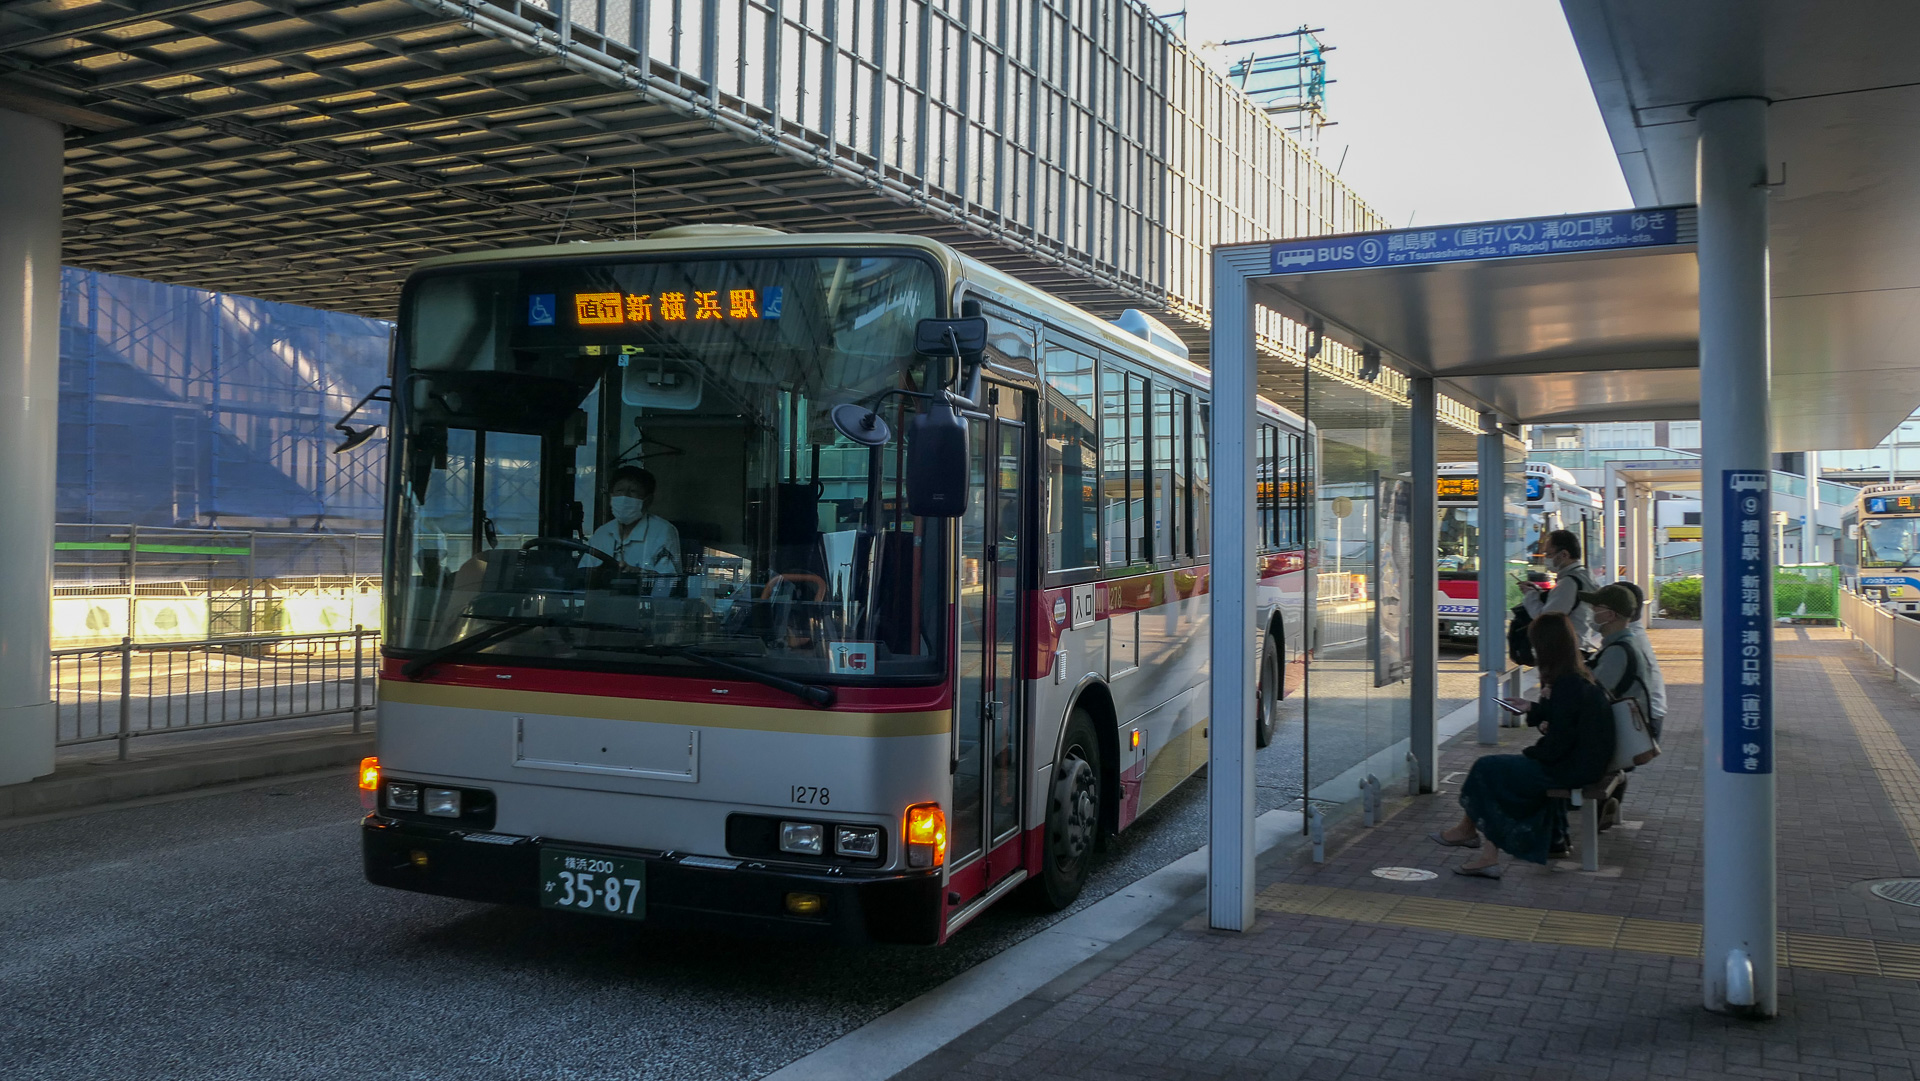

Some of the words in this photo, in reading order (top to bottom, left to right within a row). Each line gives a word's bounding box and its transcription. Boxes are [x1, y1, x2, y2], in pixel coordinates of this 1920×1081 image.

[1631, 213, 1666, 230] ゆき
[1317, 245, 1355, 262] BUS
[1388, 251, 1406, 262] For
[1409, 244, 1499, 260] Tsunashima-sta.
[1509, 241, 1549, 255] (Rapid)
[1552, 233, 1655, 249] Mizonokuchi-sta.
[577, 296, 622, 322] 直行
[626, 289, 759, 322] 新横浜駅
[1075, 594, 1092, 620] 入口
[1742, 743, 1761, 770] ゆき
[791, 785, 830, 806] 1278
[545, 881, 556, 892] か
[559, 871, 641, 914] 35-87
